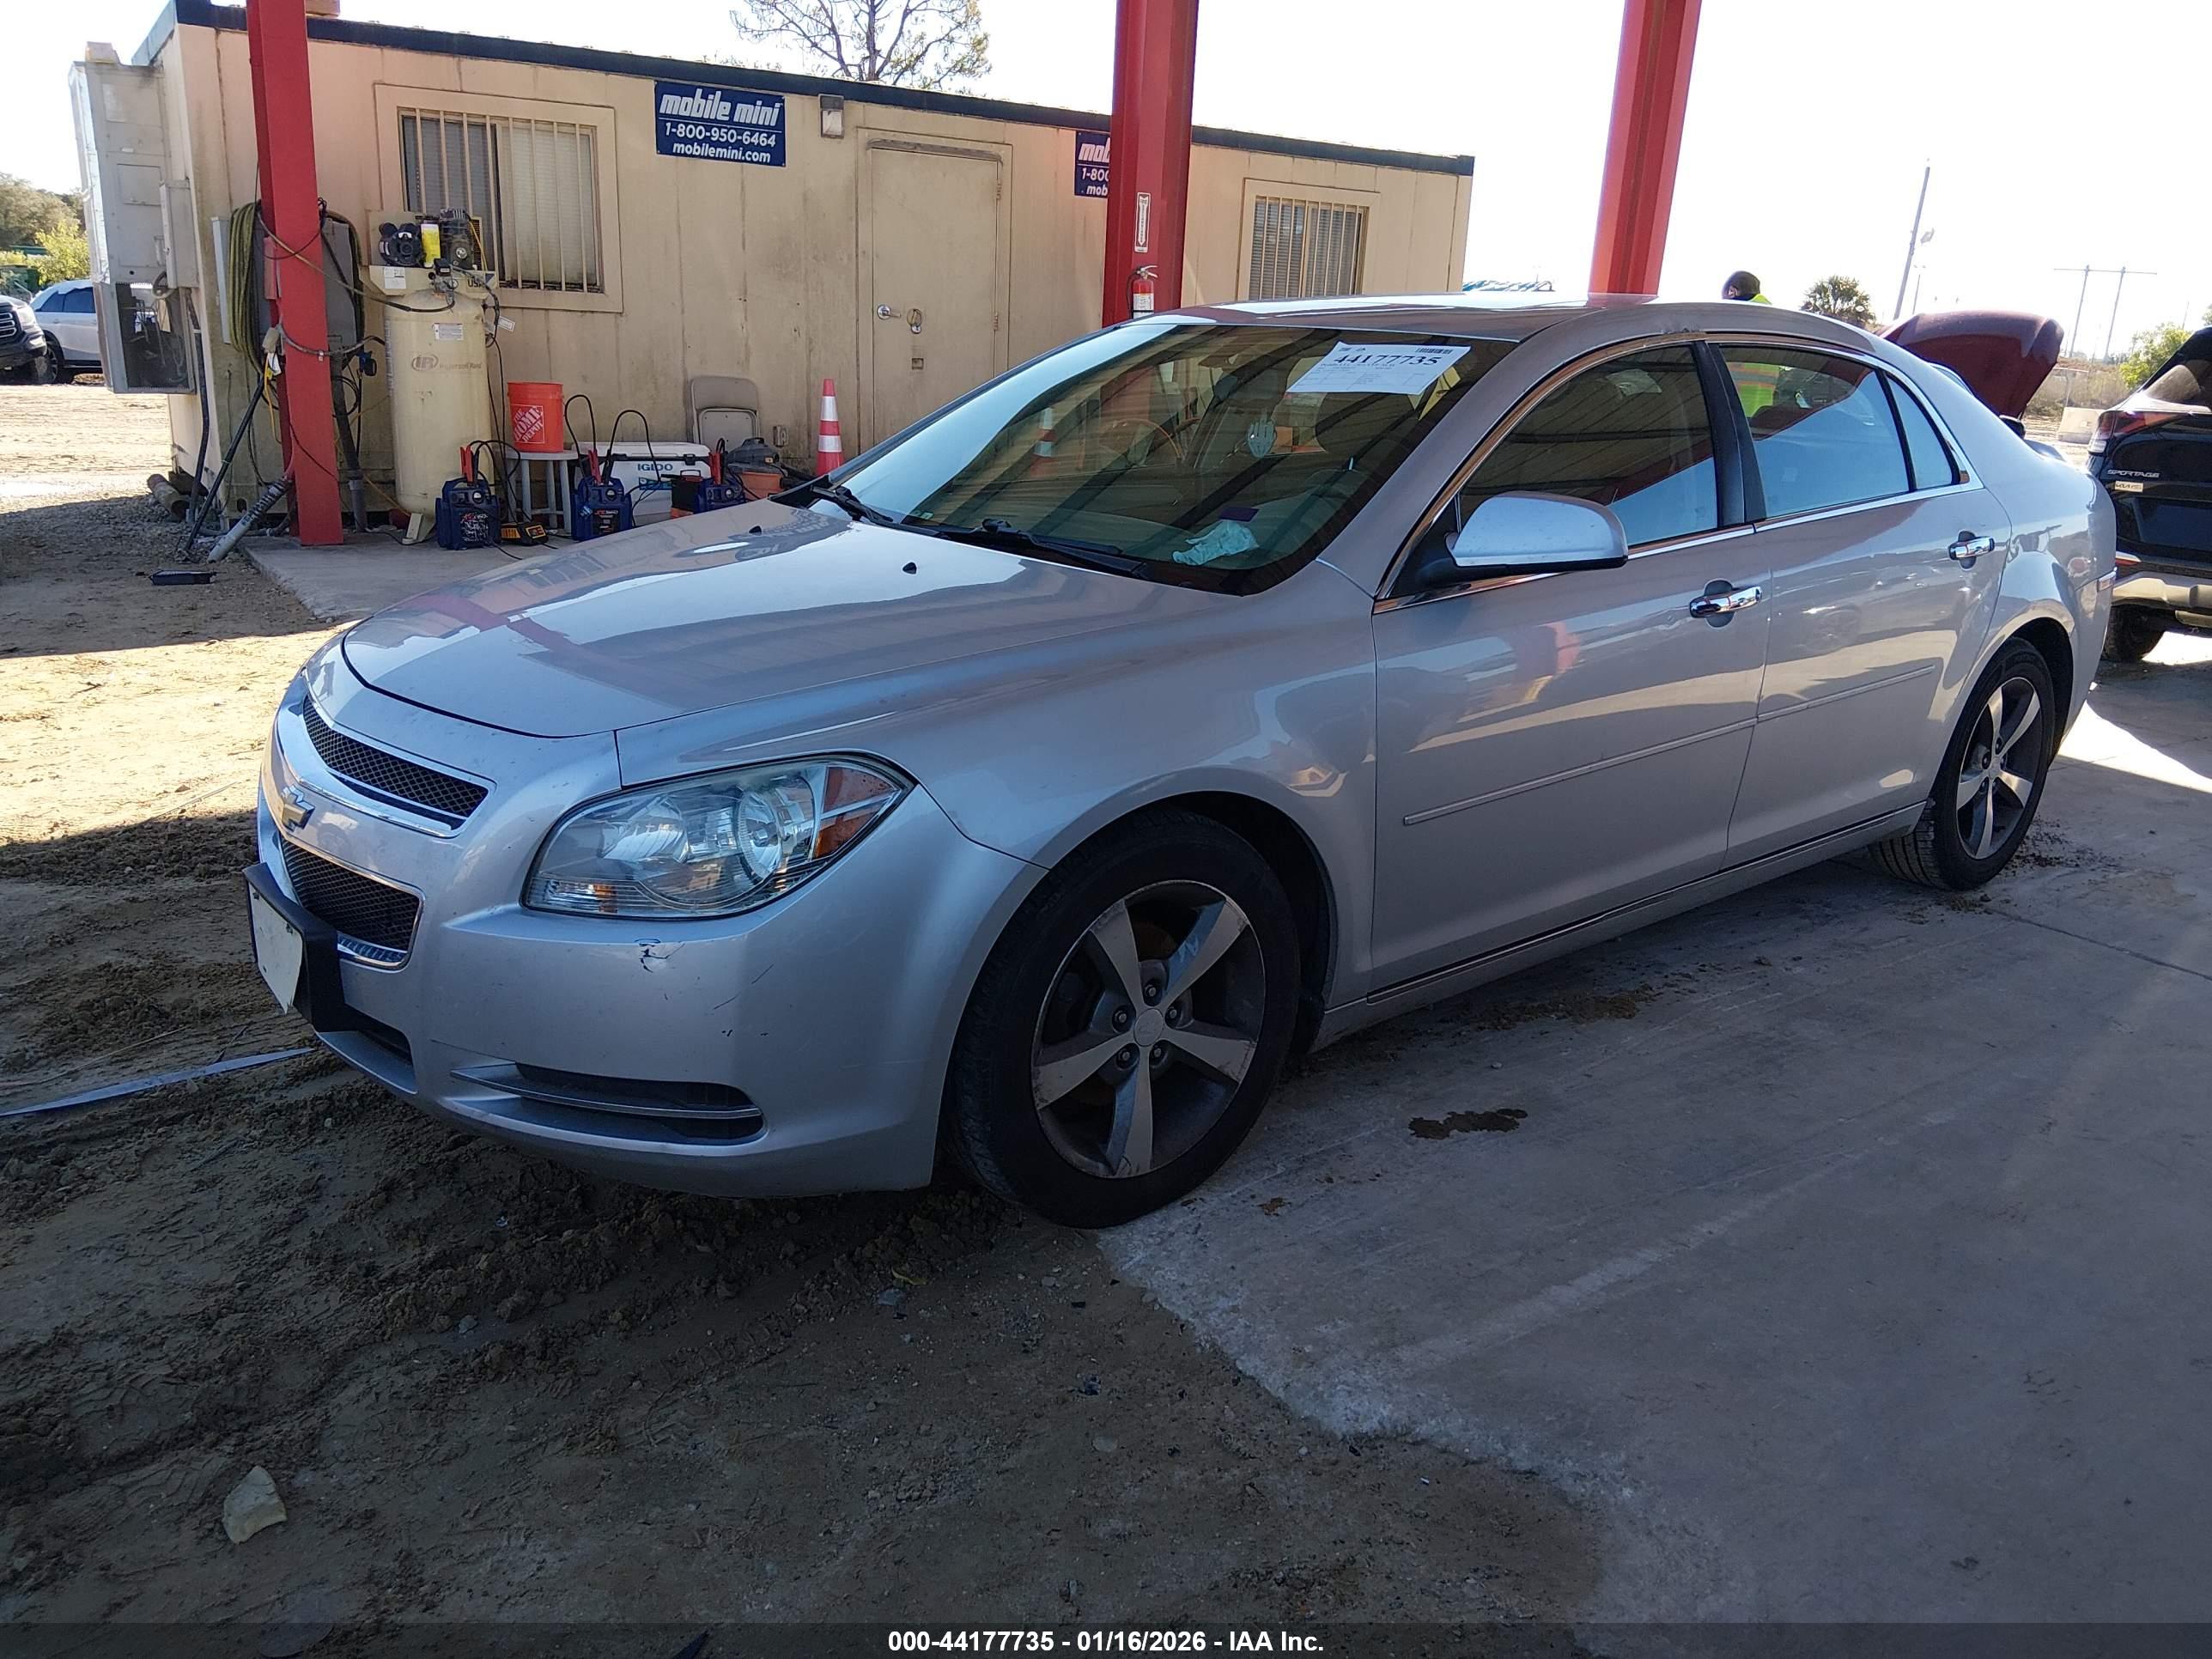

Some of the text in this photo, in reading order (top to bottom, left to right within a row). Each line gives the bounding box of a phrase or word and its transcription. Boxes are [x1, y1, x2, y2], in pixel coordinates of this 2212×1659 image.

[659, 88, 781, 126] mobile mini
[665, 122, 776, 147] 1-800-950-6464
[672, 142, 771, 163] mobilemini.com
[1334, 355, 1441, 366] 44177735
[637, 463, 673, 471] IGLOO
